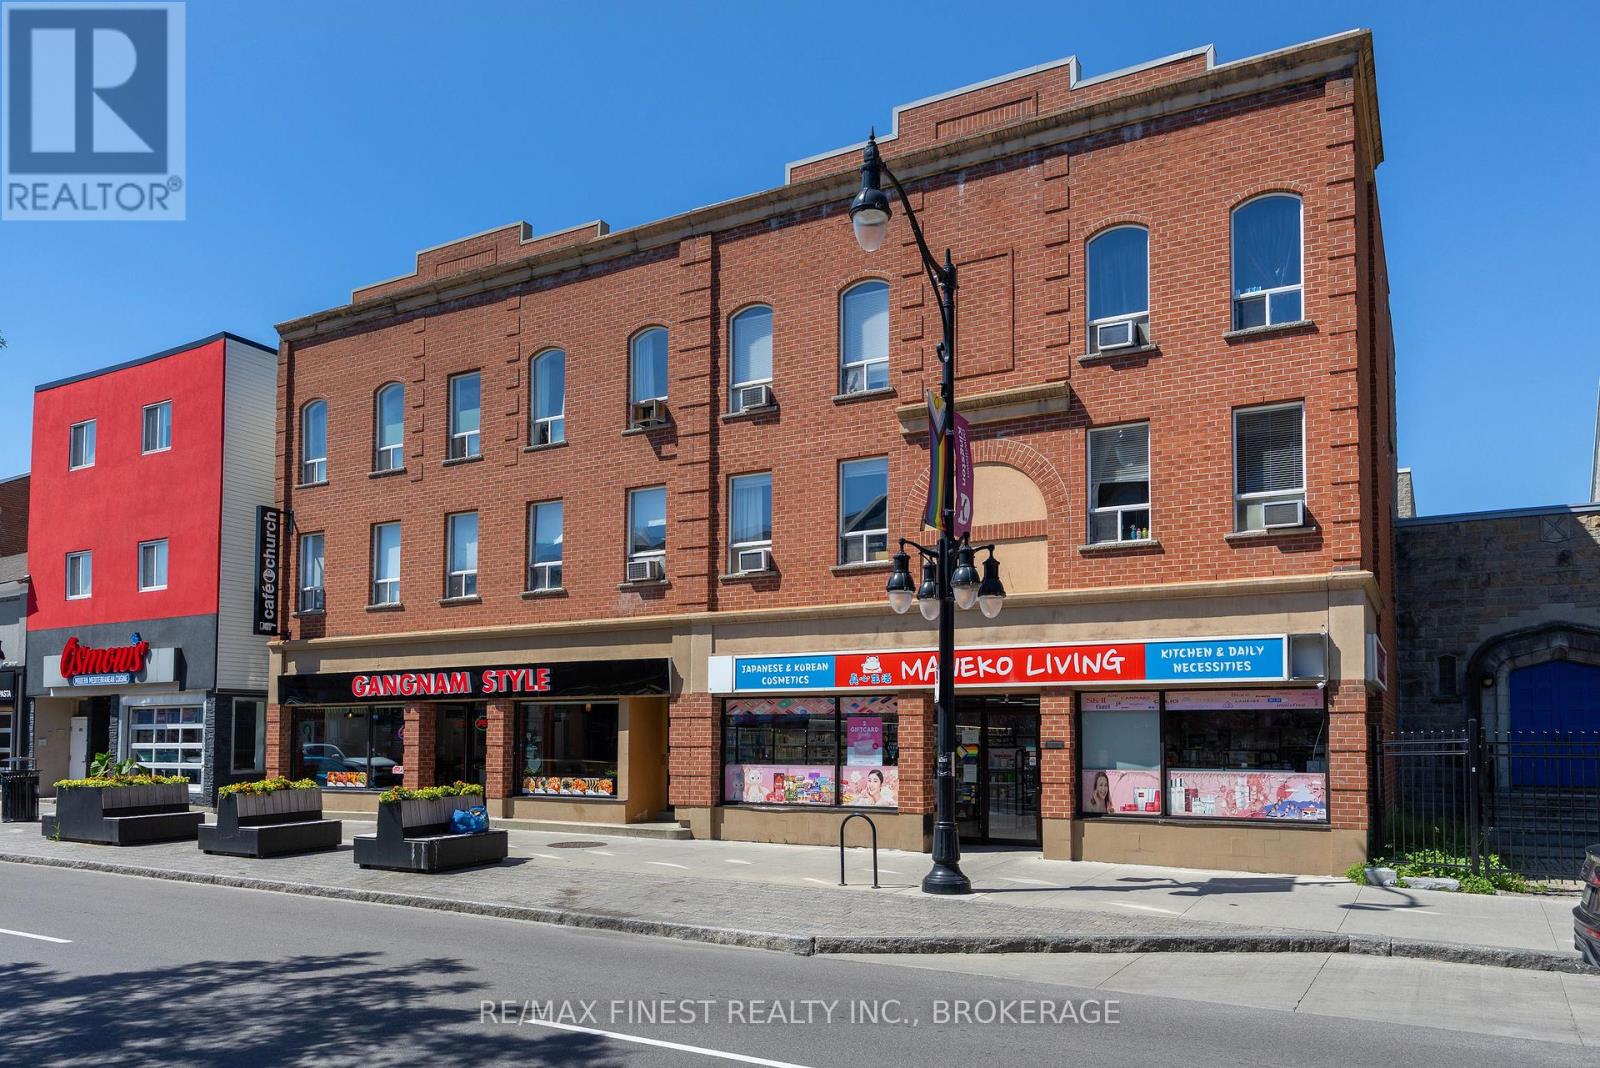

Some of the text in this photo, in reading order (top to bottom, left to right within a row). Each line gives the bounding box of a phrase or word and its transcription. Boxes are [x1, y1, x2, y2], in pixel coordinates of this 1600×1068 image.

[262, 511, 277, 619] café church
[1161, 645, 1265, 659] KITCHEN & DAILY
[741, 662, 829, 674] JAPANESE & KOREAN
[901, 648, 1126, 682] MAEKO LIVING
[1173, 660, 1252, 673] NECESSITIES
[351, 668, 551, 697] GANGNAM STYLE
[761, 675, 809, 685] COSMETICS
